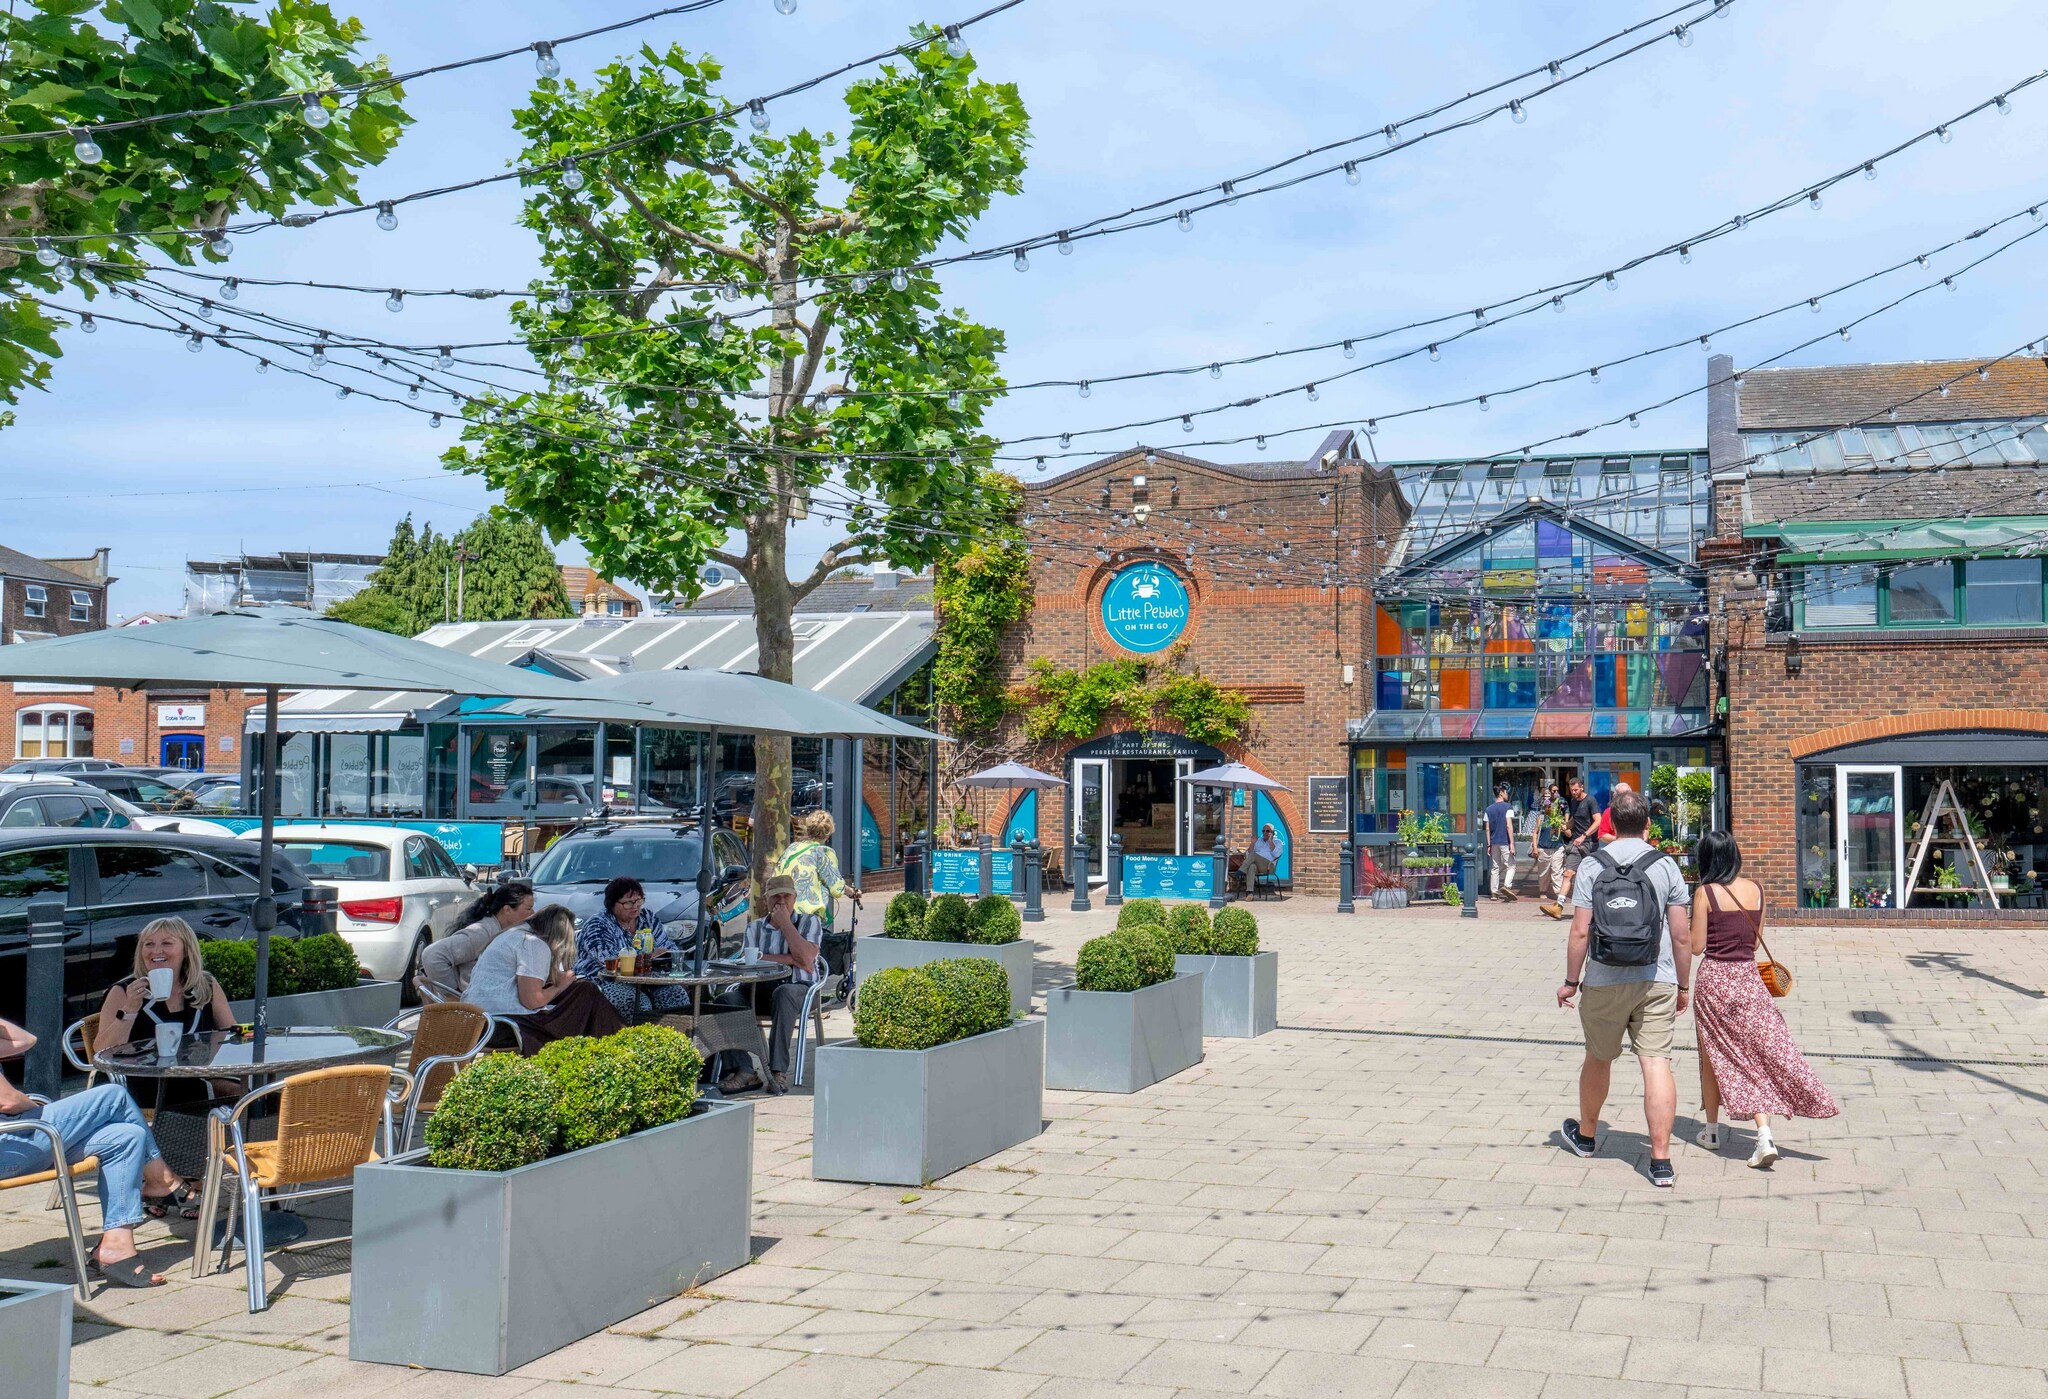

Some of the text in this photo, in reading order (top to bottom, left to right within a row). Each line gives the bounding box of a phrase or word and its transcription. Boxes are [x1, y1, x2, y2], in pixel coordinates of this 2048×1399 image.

[1108, 602, 1184, 621] Little Pebbles
[1156, 622, 1169, 630] GO
